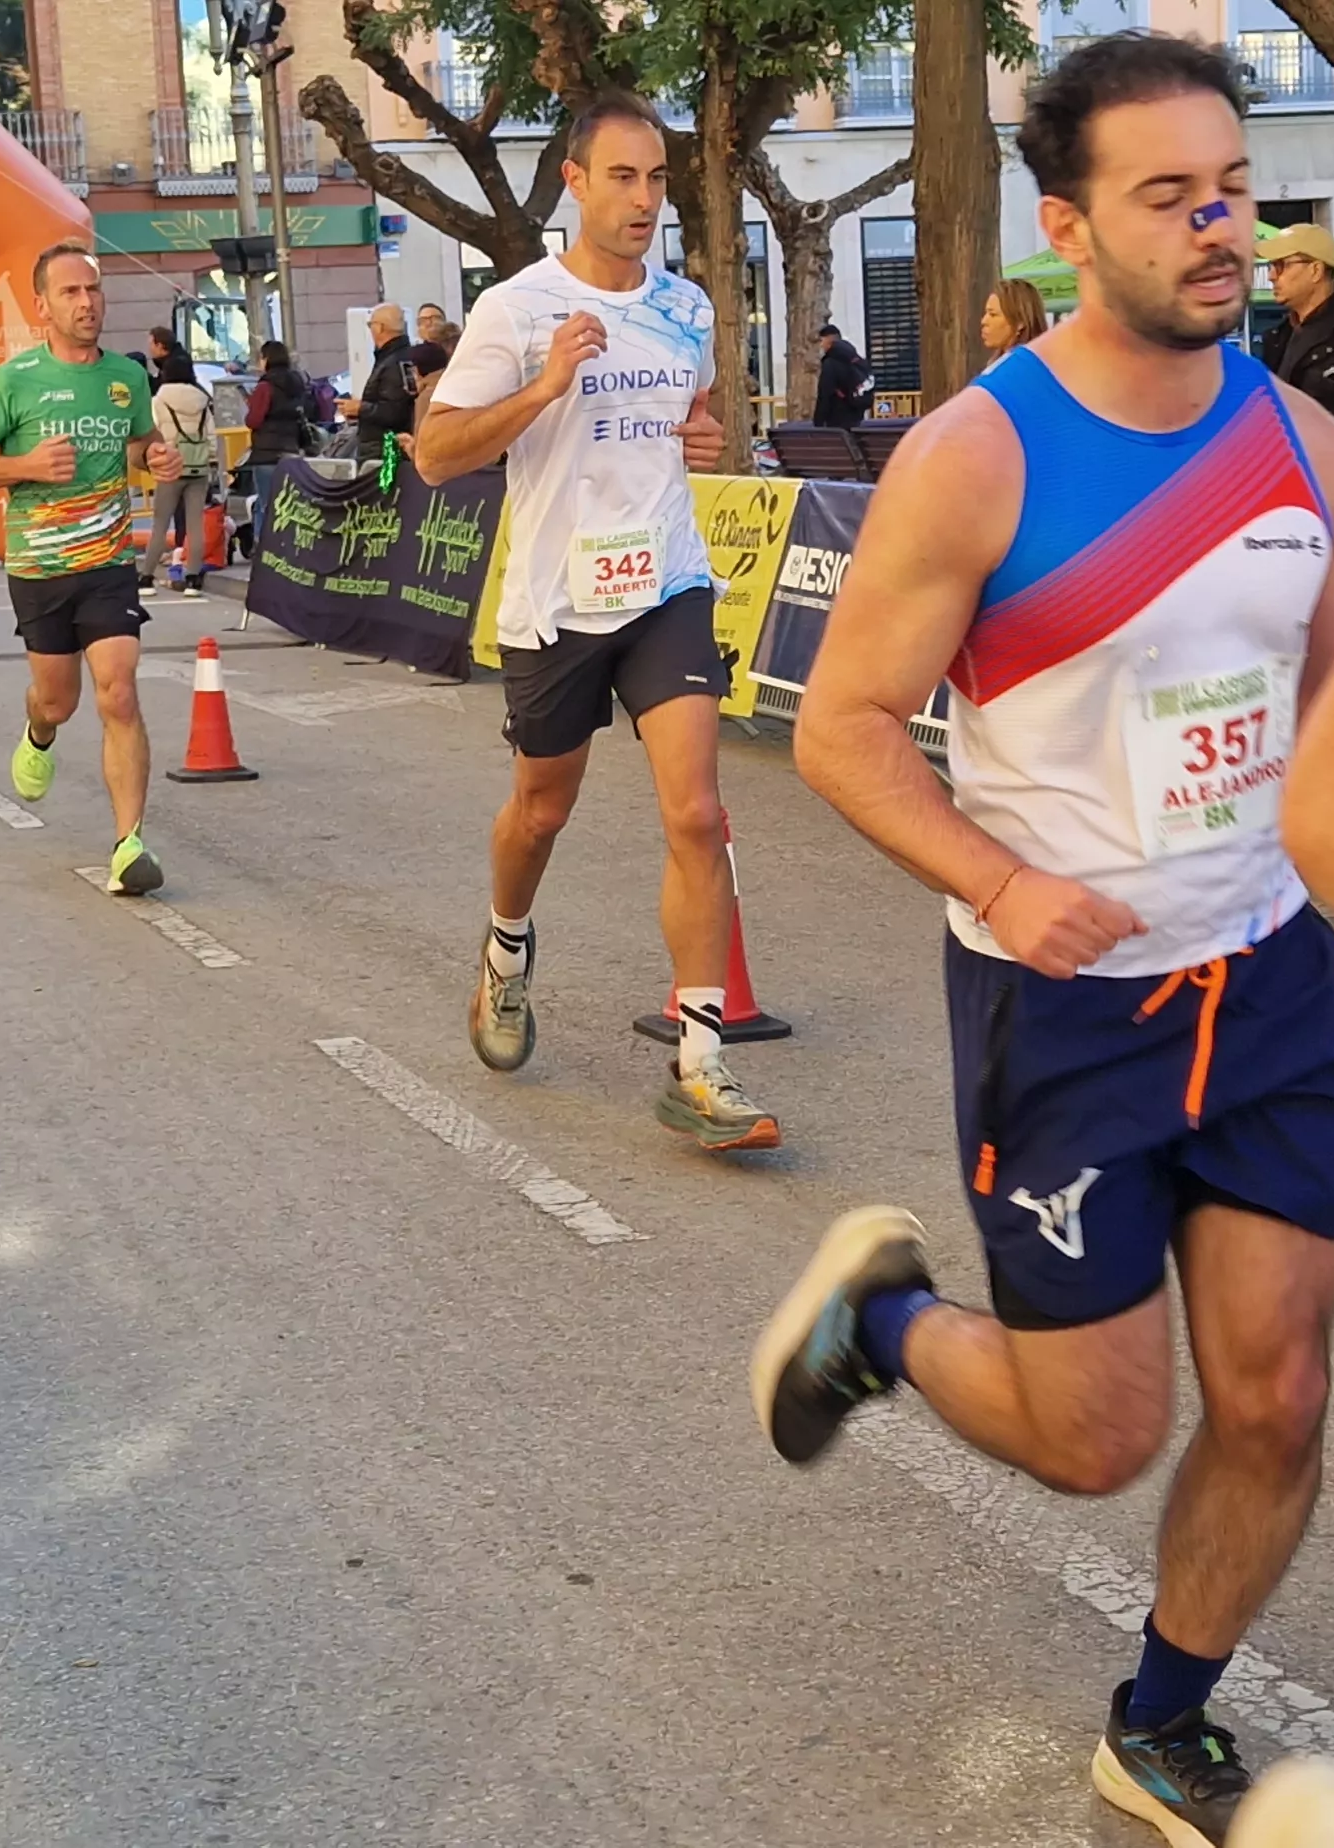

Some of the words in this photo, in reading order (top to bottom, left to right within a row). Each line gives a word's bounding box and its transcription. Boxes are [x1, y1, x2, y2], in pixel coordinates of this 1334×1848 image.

[595, 551, 654, 581] 342
[593, 578, 657, 596] ALBERTO
[604, 596, 625, 608] 8K
[1181, 705, 1268, 775] 357
[1162, 756, 1287, 812] ALEJANDRO
